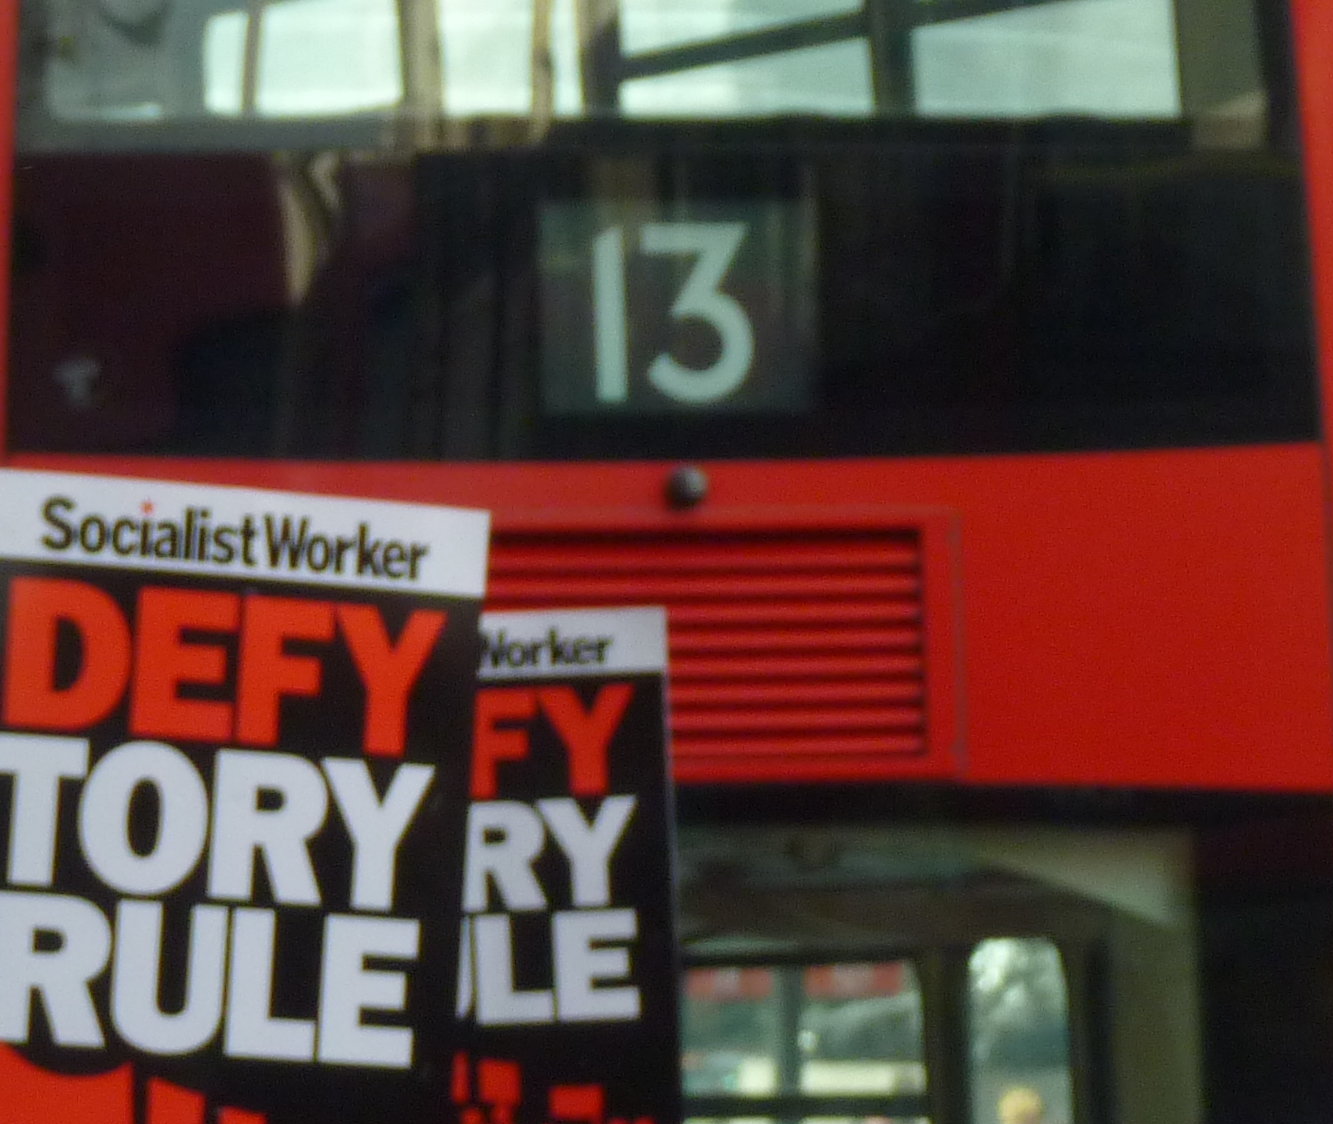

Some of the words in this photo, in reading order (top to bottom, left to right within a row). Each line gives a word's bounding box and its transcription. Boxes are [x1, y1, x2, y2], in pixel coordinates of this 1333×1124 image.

[592, 219, 756, 403] 13
[2, 575, 448, 758] DEFY
[469, 683, 635, 799] FY
[0, 732, 437, 912] TORY
[462, 794, 638, 912] RY
[0, 889, 421, 1070] RULE
[455, 907, 642, 1028] LE
